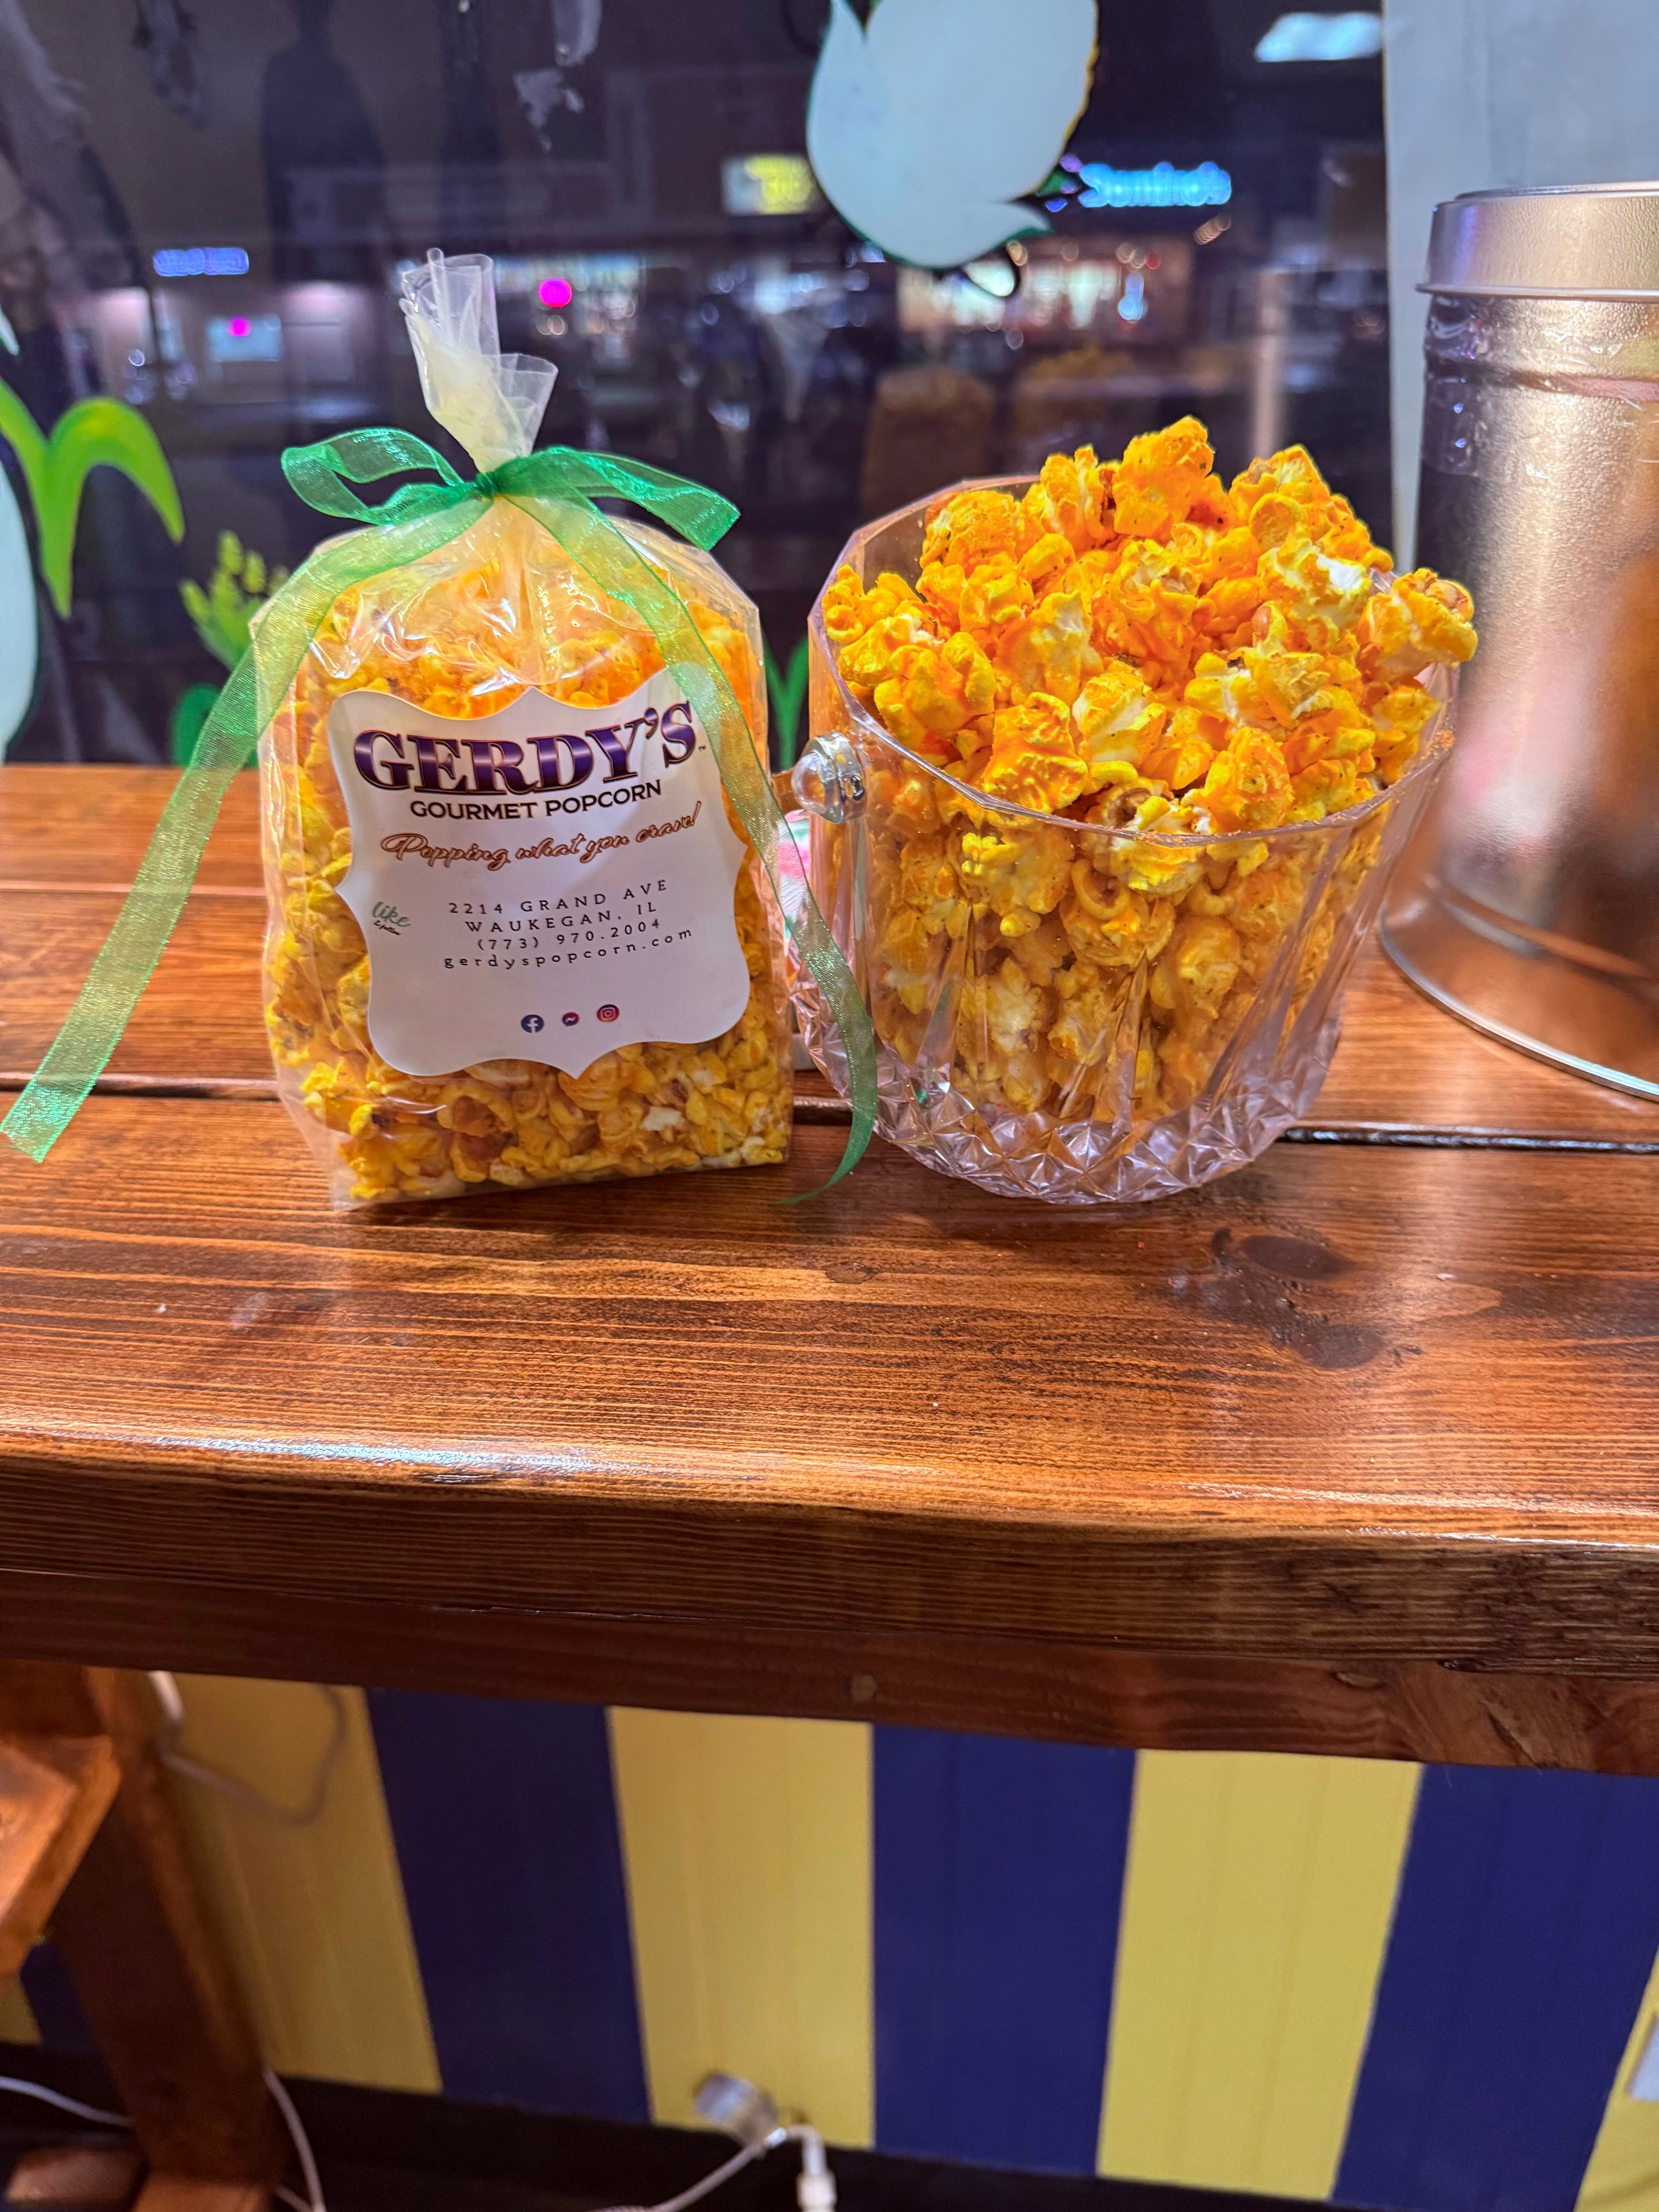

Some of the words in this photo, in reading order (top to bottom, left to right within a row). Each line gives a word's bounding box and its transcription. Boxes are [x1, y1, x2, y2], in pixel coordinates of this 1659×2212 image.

[354, 700, 696, 795] GERDY'S
[410, 800, 538, 820] GOURMET
[545, 780, 661, 817] POPCORN
[381, 833, 511, 871] Popping
[515, 833, 586, 860] what
[579, 835, 630, 864] you
[373, 901, 411, 927] like
[449, 902, 503, 915] 2214
[520, 893, 606, 912] GRAND
[623, 880, 666, 900] AVE
[637, 902, 656, 915] IL
[445, 929, 692, 969] gerdyspopcorn.com
[478, 937, 539, 951] (773)
[556, 919, 659, 945] 970.2004
